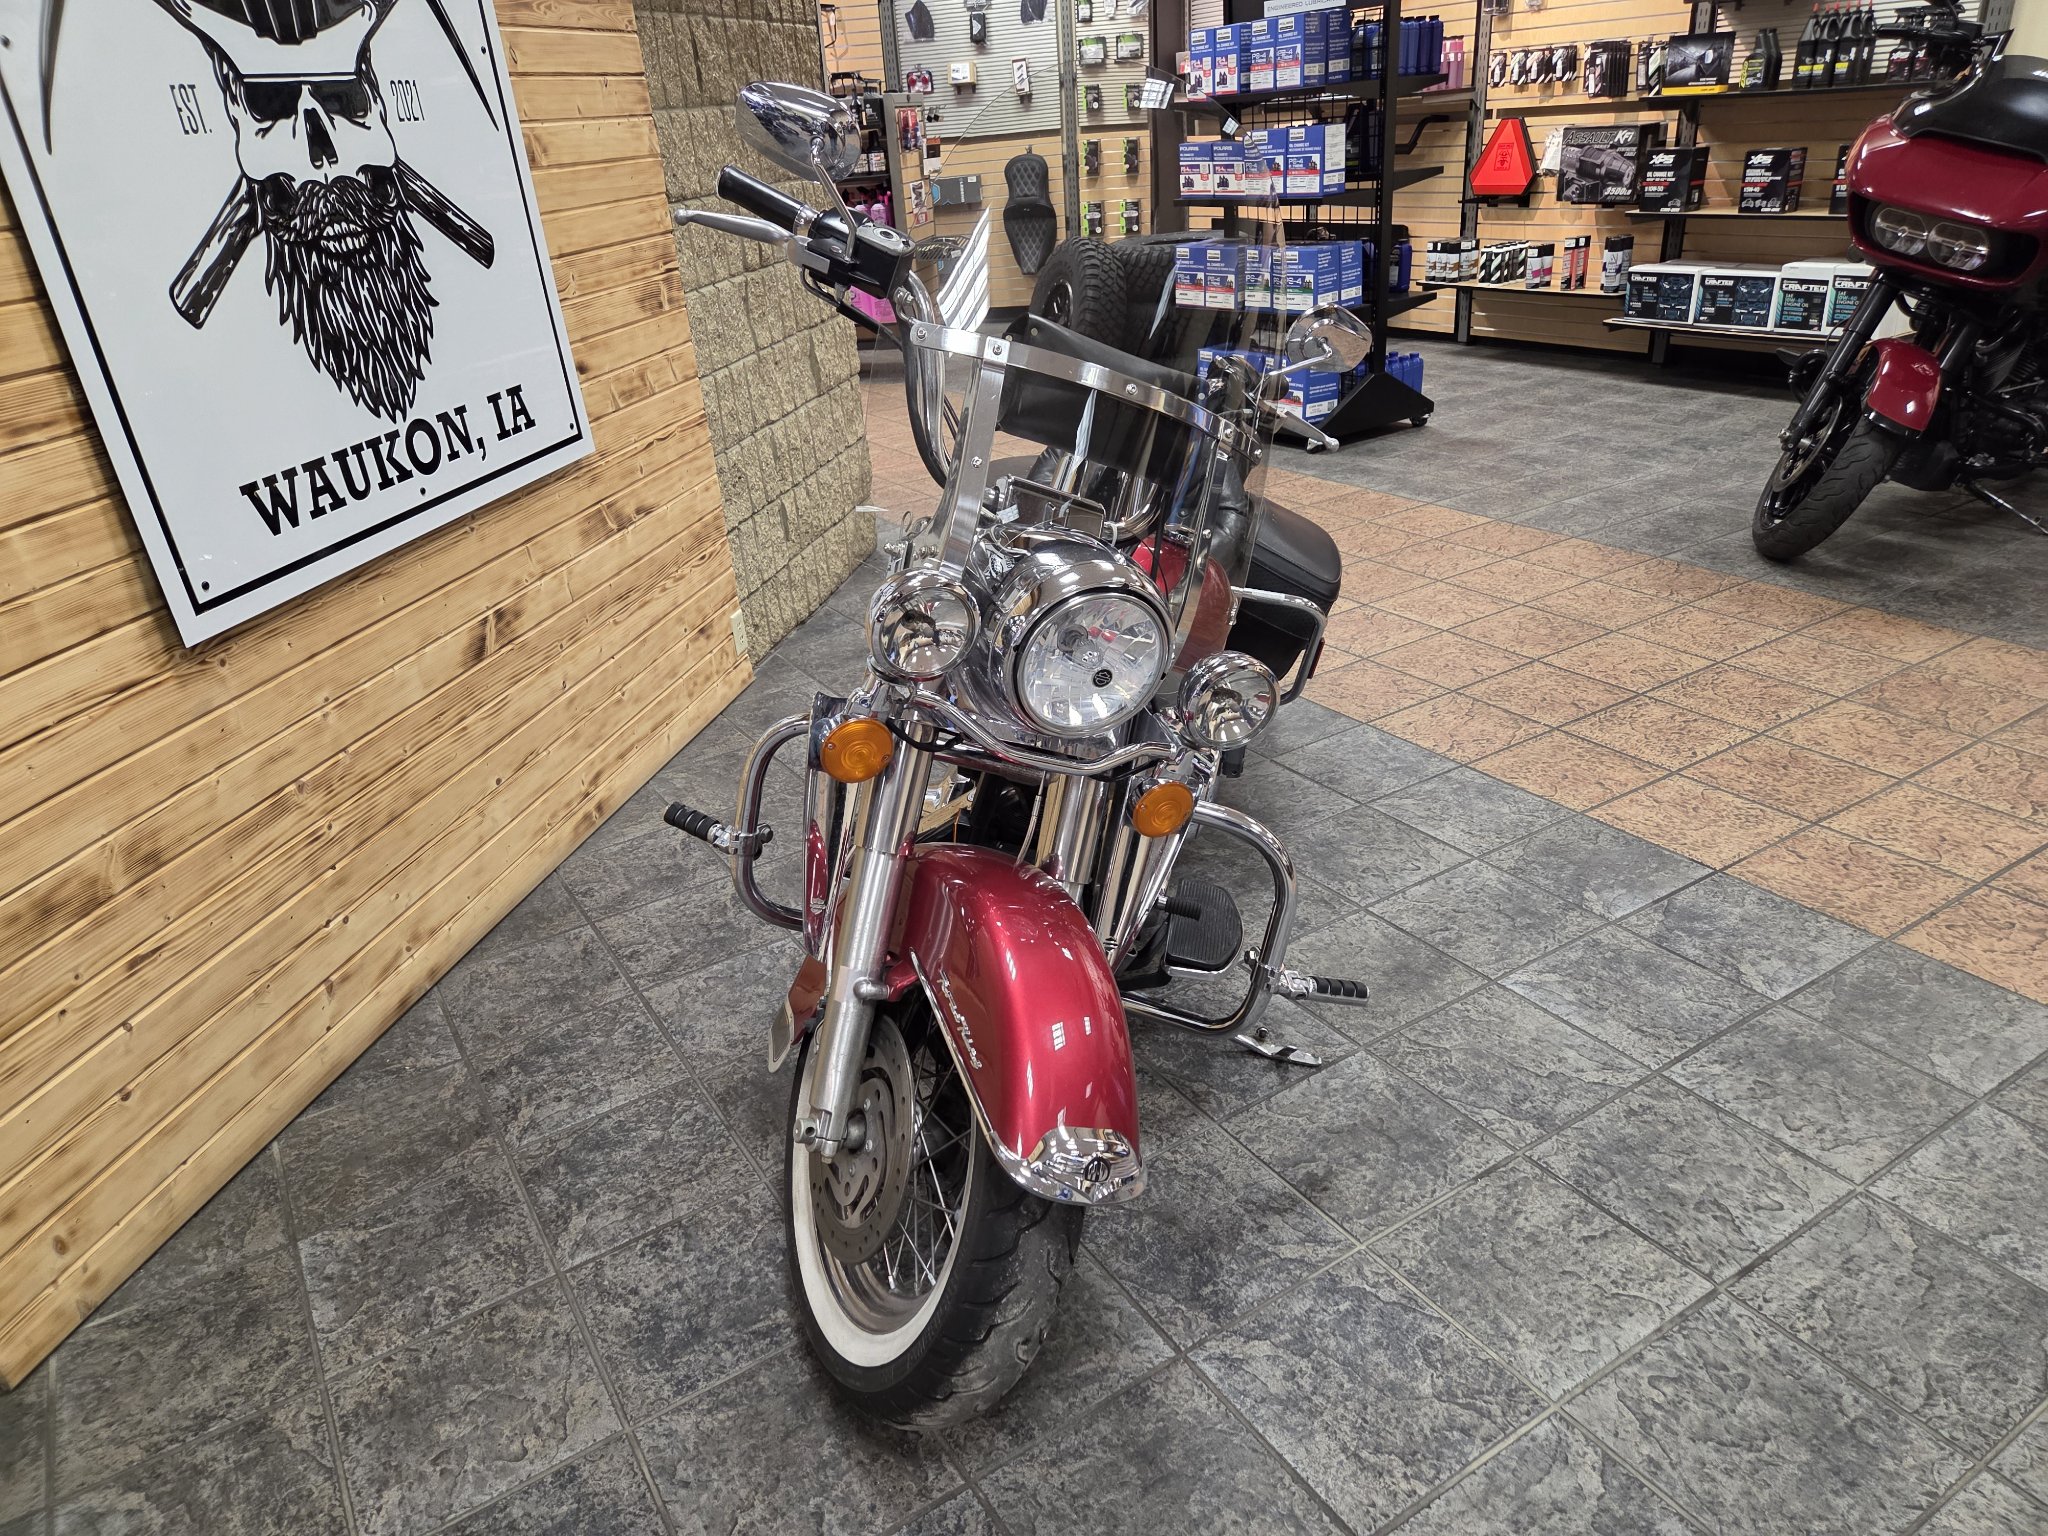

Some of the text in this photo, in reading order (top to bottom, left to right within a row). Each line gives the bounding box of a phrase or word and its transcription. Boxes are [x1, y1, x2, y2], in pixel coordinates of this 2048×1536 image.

[169, 84, 213, 136] EST.
[390, 80, 425, 122] 2021
[1782, 283, 1828, 294] CRAFTED
[1834, 281, 1871, 290] CRAFT
[238, 384, 537, 537] WAUKON, IA
